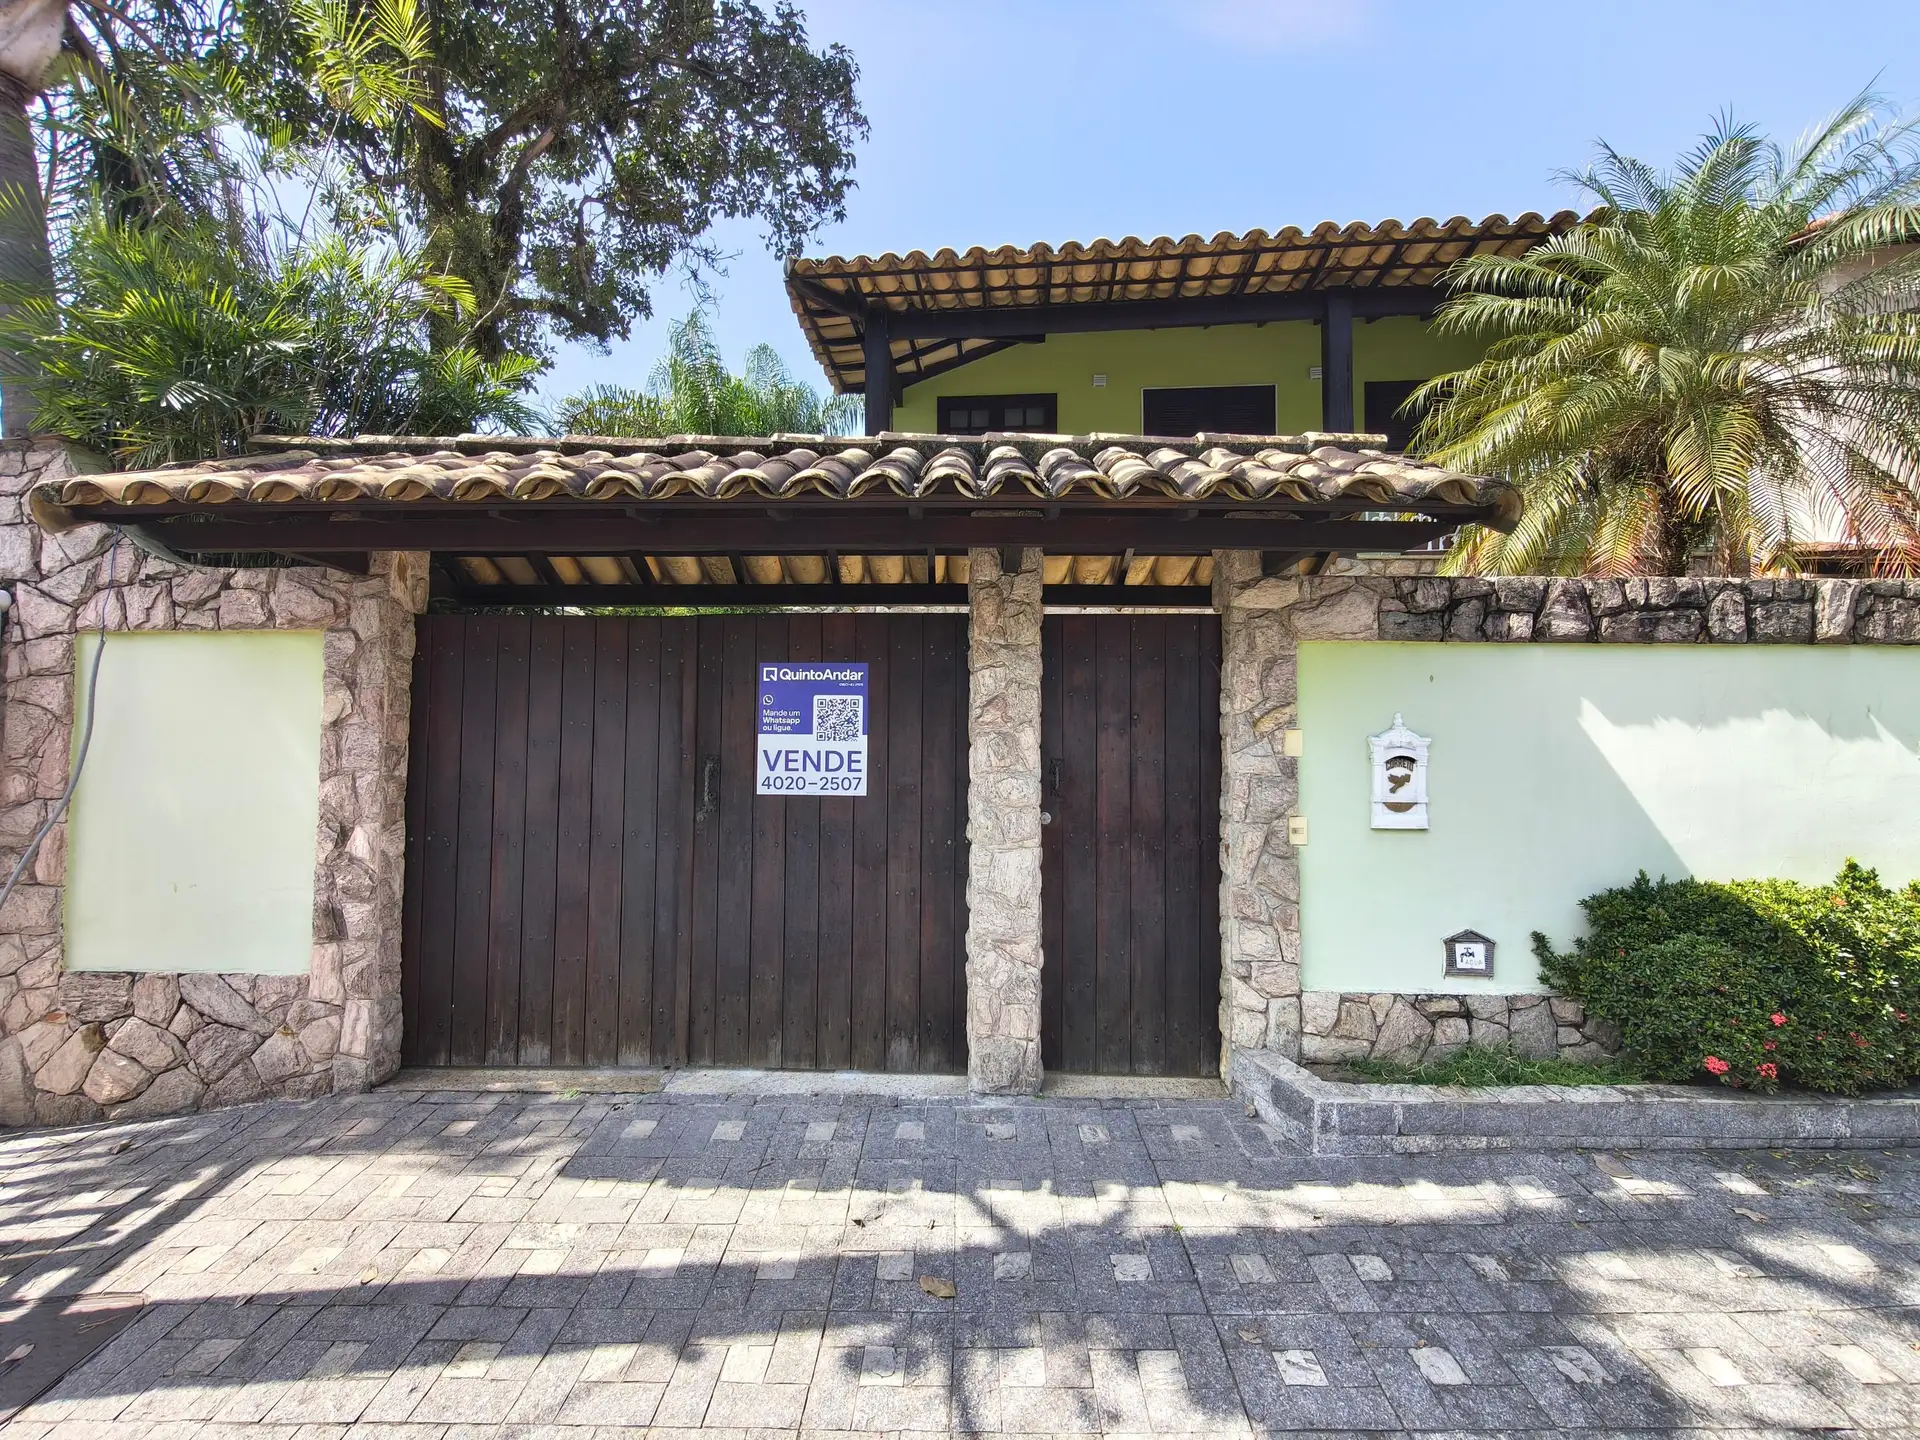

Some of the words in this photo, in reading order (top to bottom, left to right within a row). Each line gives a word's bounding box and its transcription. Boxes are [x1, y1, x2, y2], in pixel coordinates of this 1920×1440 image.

[779, 668, 864, 681] QuintoAndar
[763, 717, 800, 725] Whatsapp
[762, 750, 862, 773] VENDE
[1386, 758, 1414, 772] CORREIO
[761, 776, 862, 791] 4020-2507
